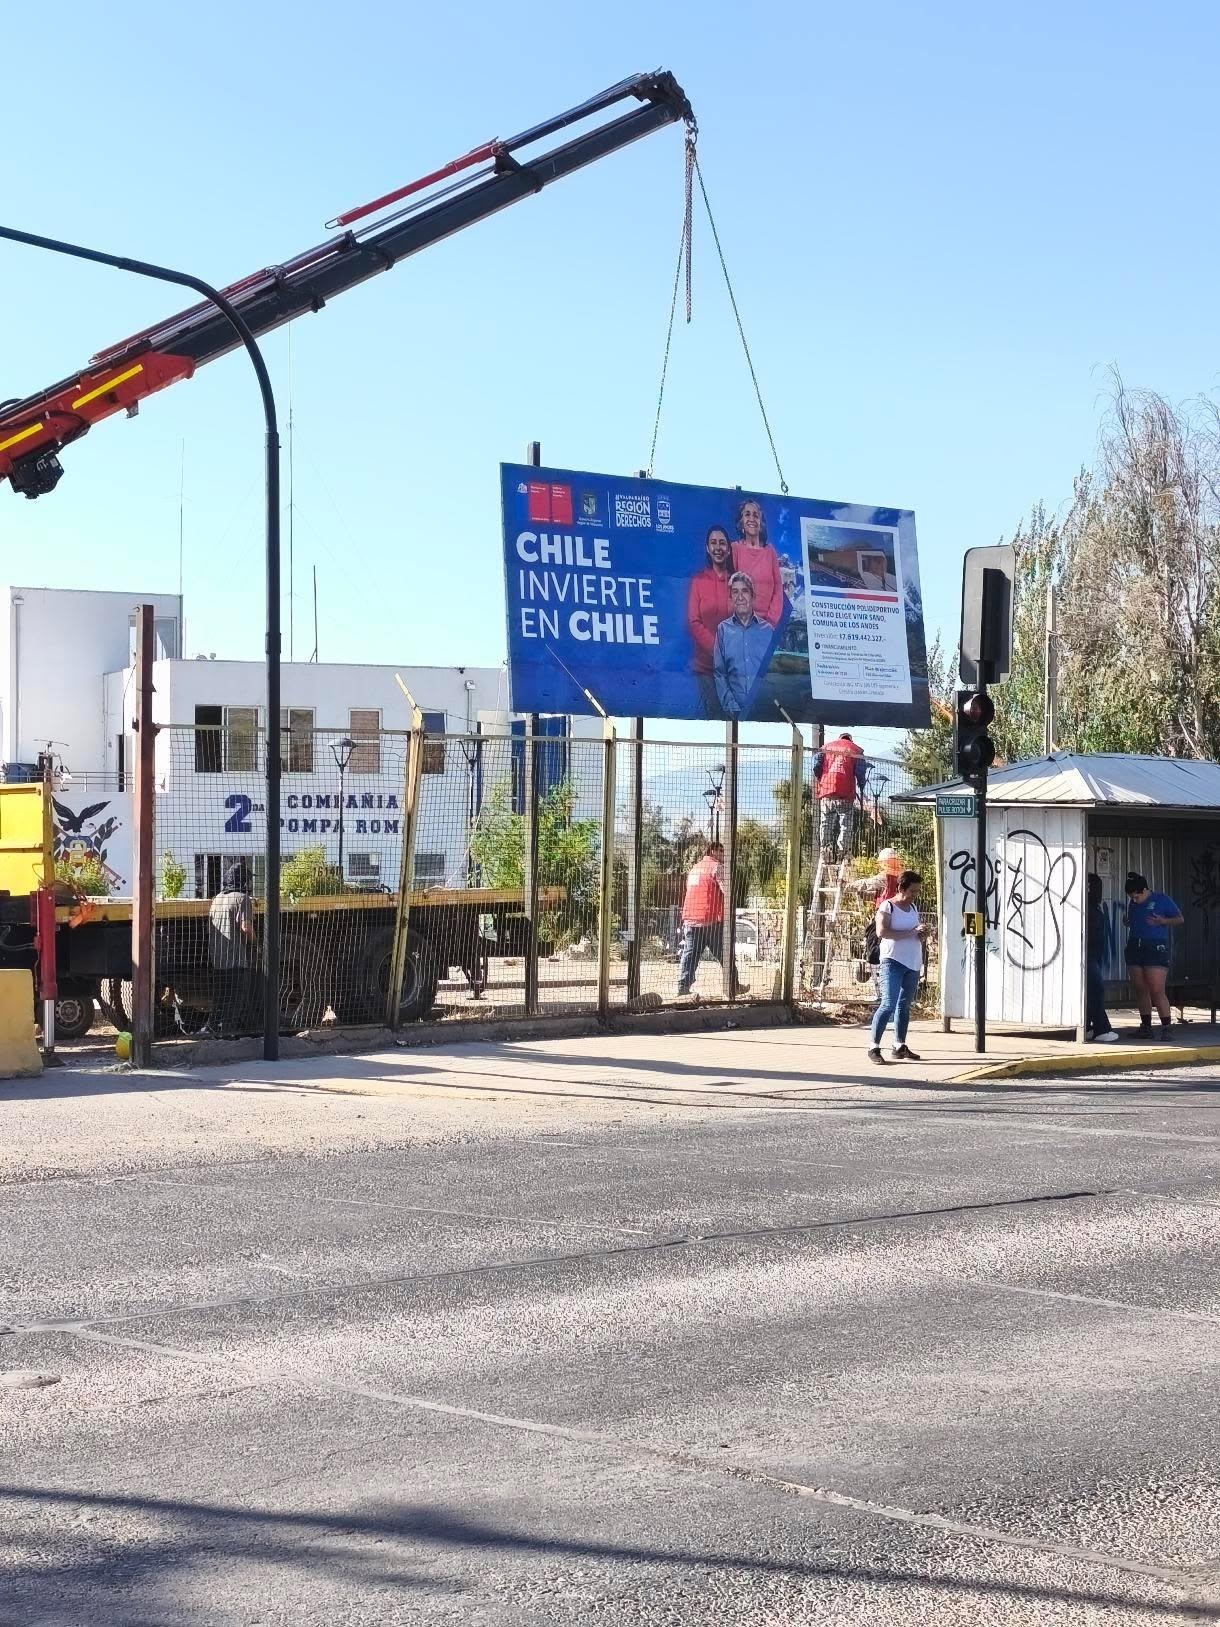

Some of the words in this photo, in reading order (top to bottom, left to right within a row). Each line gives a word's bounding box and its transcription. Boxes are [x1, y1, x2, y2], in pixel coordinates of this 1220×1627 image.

[615, 499, 651, 515] REGIÓN
[615, 514, 652, 528] DERECHOS
[516, 531, 612, 569] CHILE
[519, 569, 654, 608] INVIERTE
[811, 601, 856, 611] CONSTRUCCIÓN
[856, 604, 900, 614] POLIDEPORTIVO
[812, 610, 835, 618] CENTRO
[521, 607, 559, 640] EN
[568, 610, 660, 645] CHILE
[812, 619, 839, 628] COMUNA
[287, 792, 399, 809] COMPAÑIA
[355, 819, 405, 834] ROM
